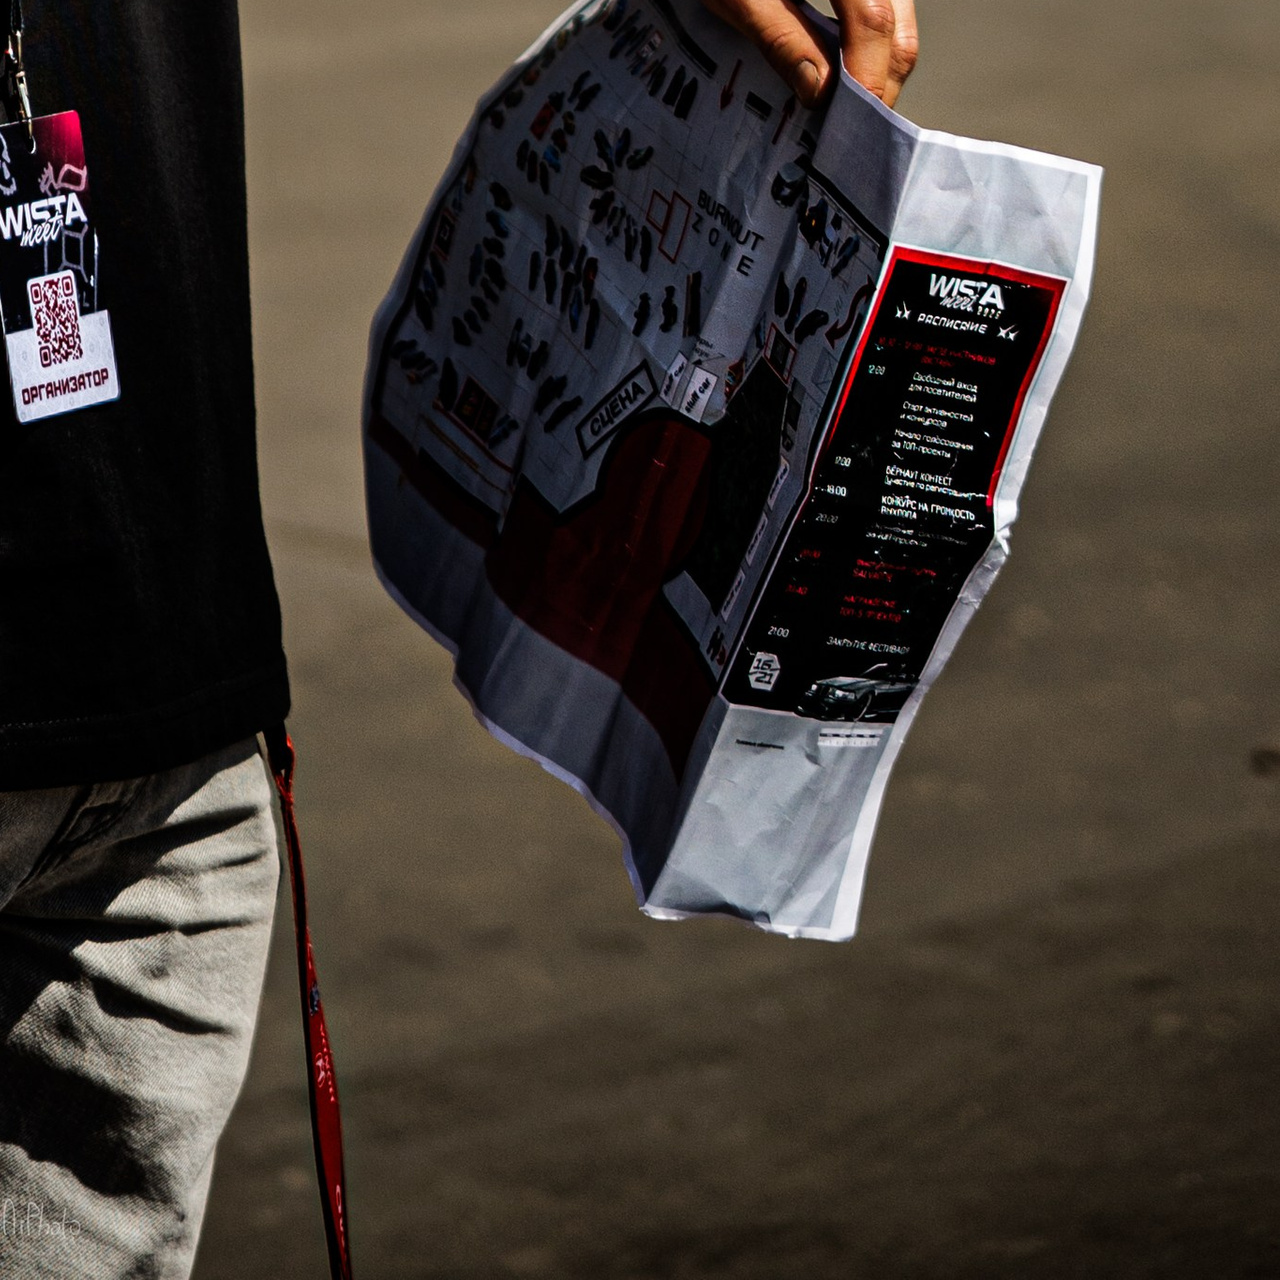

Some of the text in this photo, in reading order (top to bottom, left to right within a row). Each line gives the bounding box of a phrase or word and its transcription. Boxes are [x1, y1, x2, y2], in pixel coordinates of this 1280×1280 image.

[20, 211, 64, 247] meet
[696, 188, 765, 252] BURNOUT
[928, 273, 1006, 310] WISTA
[917, 312, 989, 334] РАСПИСАНИЕ
[673, 361, 686, 377] car
[21, 367, 109, 406] ОРГАНИЗАТОР
[908, 383, 977, 403] для посетителей
[912, 371, 979, 394] Свободный вход
[685, 377, 711, 414] stuff car
[589, 381, 646, 437] СЦЕНА
[902, 401, 974, 423] Старт активностей
[891, 440, 952, 459] за ТОП-проекты
[894, 428, 975, 452] Начало голосования
[885, 465, 953, 487] БЁРНАУТ КОНТЕСТ
[916, 481, 925, 489] по
[881, 495, 976, 521] КОНКУРС НА ГРОМКОСТЬ
[767, 625, 790, 638] 21:00
[826, 636, 867, 652] ЗАКРЫТИЕ
